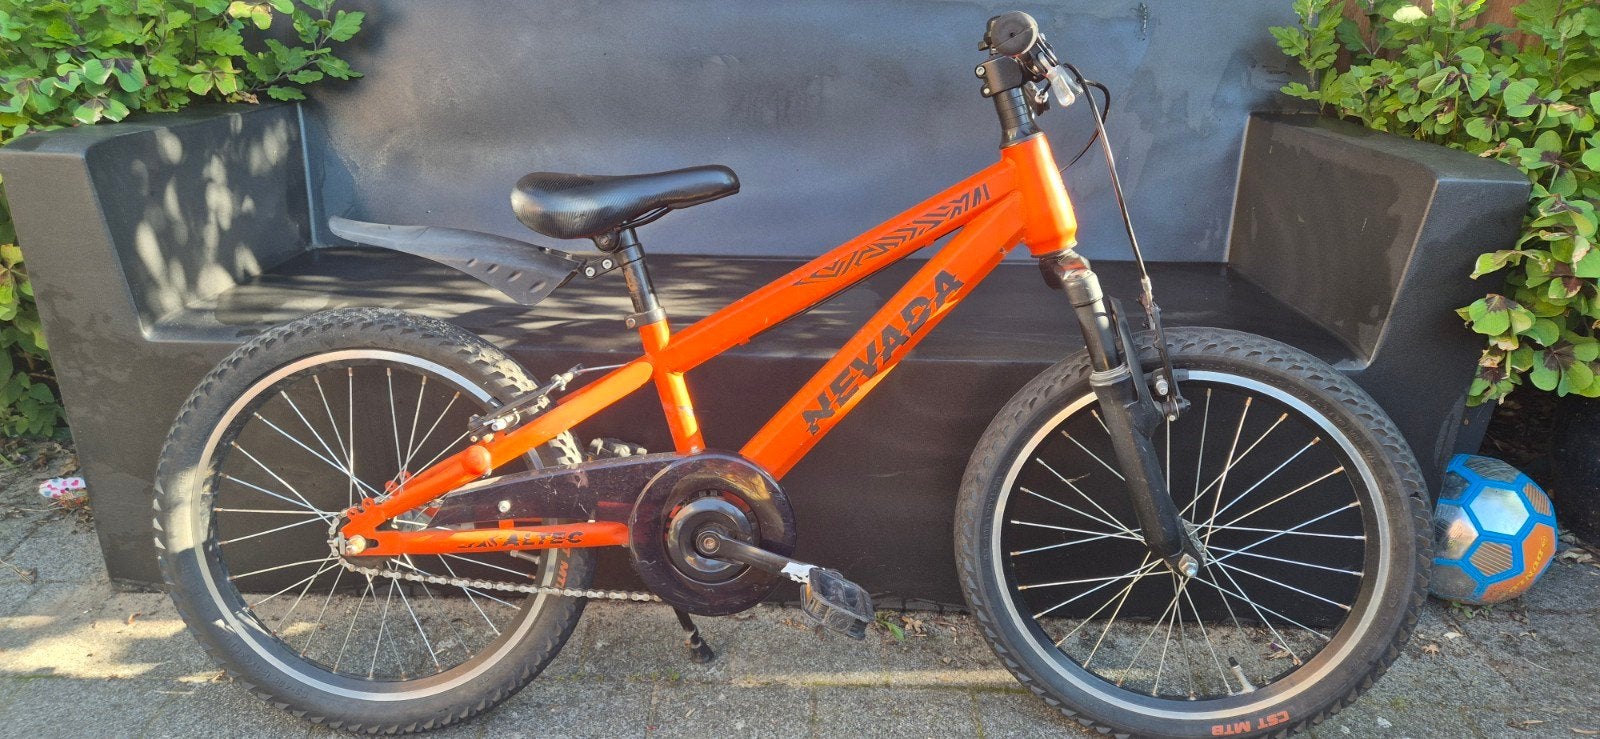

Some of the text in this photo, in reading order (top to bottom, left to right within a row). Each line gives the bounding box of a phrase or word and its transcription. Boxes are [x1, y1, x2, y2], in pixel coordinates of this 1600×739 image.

[802, 270, 965, 436] NEVADA
[502, 531, 584, 548] ALTEC
[1211, 710, 1290, 736] CST MTB
